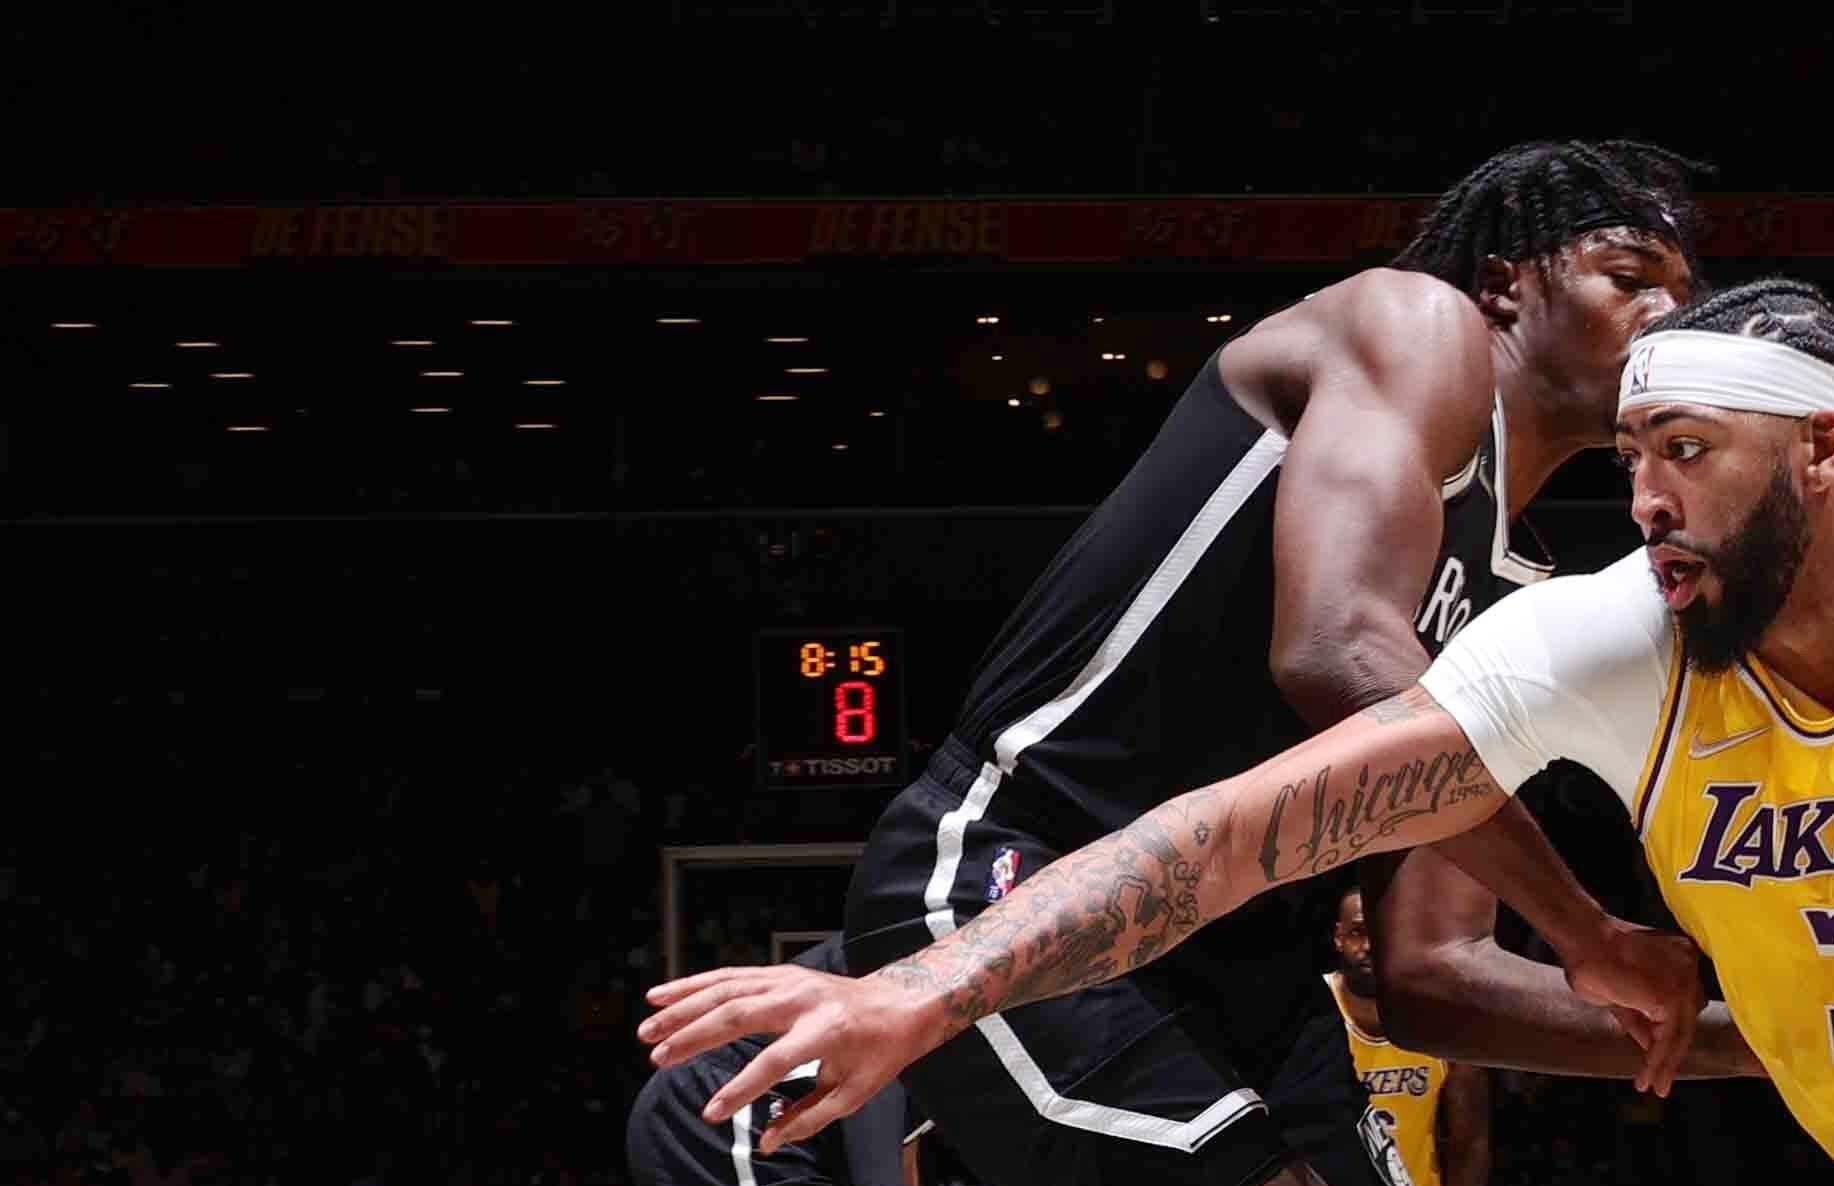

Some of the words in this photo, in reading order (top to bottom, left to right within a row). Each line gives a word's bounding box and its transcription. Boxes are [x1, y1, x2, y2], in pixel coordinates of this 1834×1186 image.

[799, 641, 886, 677] 8:15
[834, 680, 877, 744] 8
[803, 756, 897, 776] TISSOT
